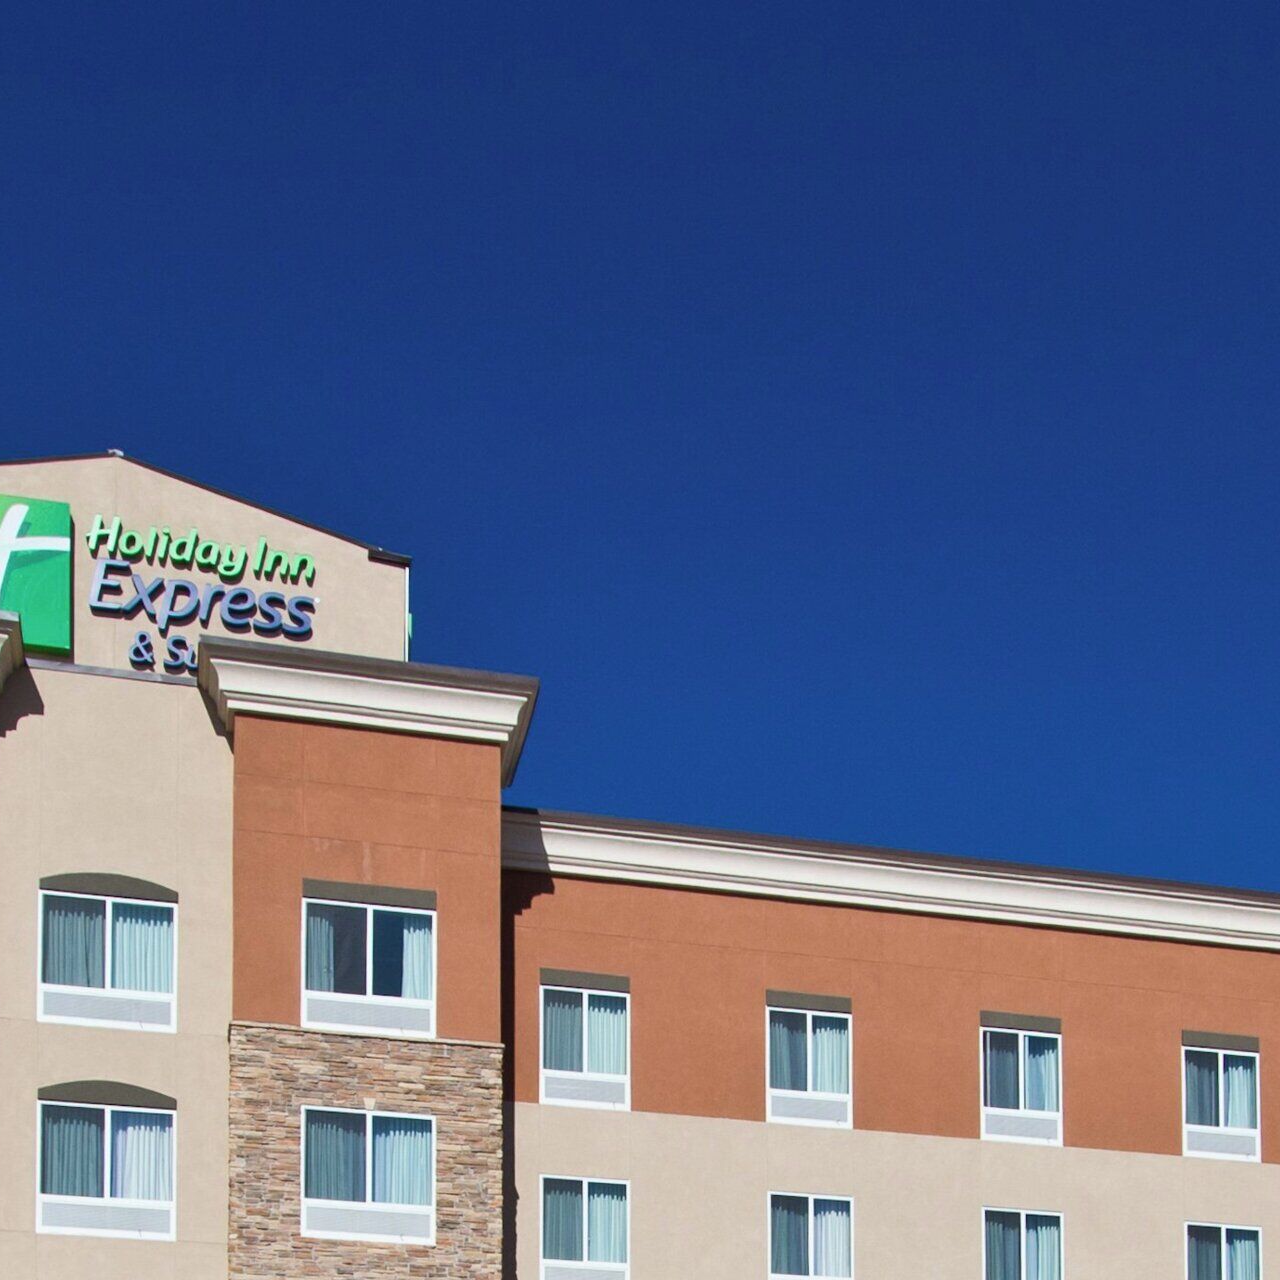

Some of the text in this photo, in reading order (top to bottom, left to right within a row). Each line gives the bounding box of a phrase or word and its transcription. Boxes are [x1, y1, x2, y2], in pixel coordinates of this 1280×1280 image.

[86, 513, 316, 581] Holiday Inn
[89, 557, 316, 635] Express
[128, 630, 154, 665] &
